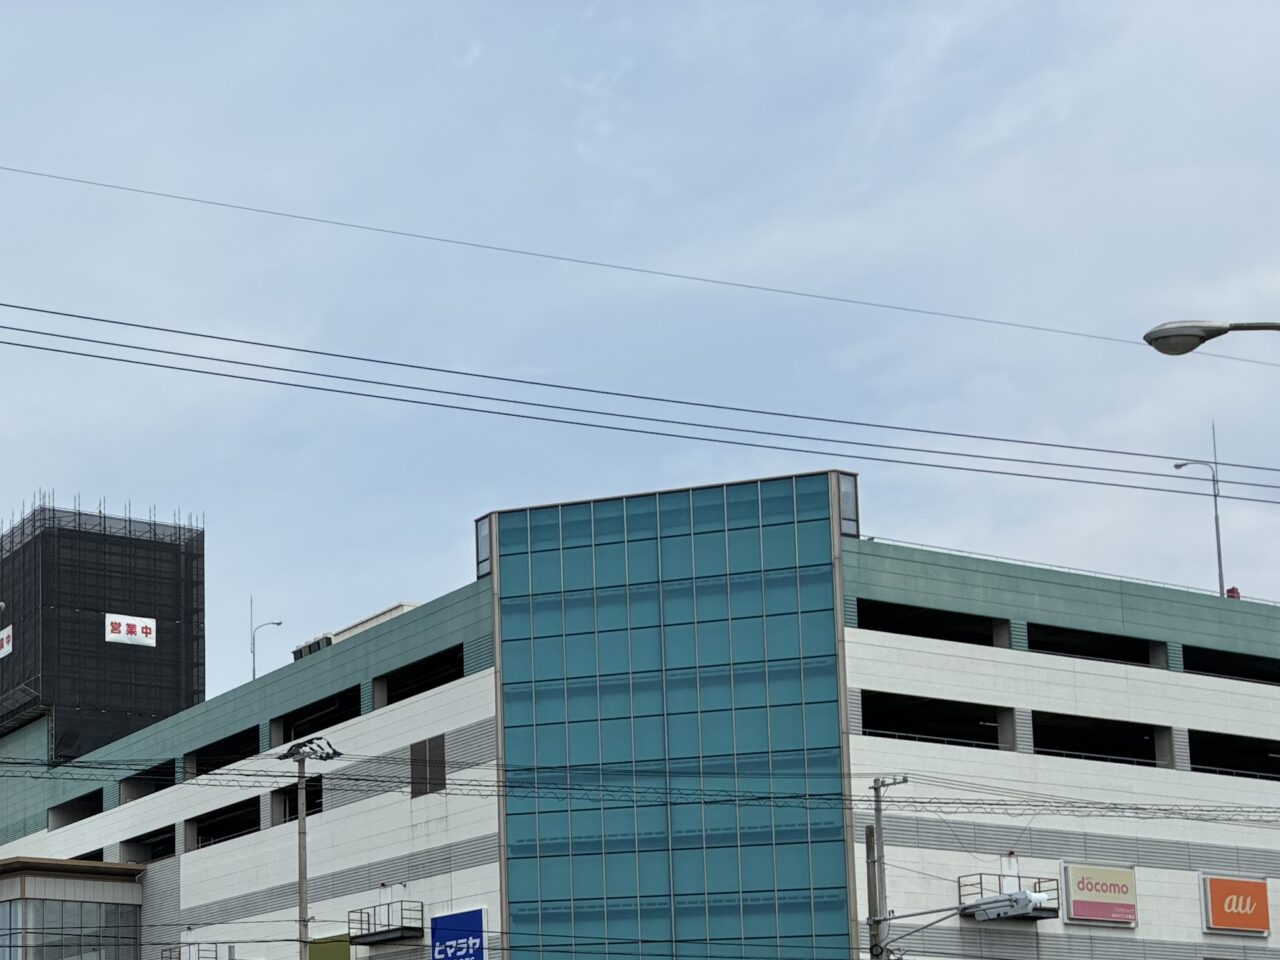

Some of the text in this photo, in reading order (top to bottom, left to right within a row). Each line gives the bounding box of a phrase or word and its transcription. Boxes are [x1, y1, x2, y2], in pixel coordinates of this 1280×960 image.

[110, 621, 153, 638] 営業中
[1077, 876, 1129, 895] docomo
[1224, 894, 1257, 914] au
[434, 936, 481, 959] ヒマラヤ
